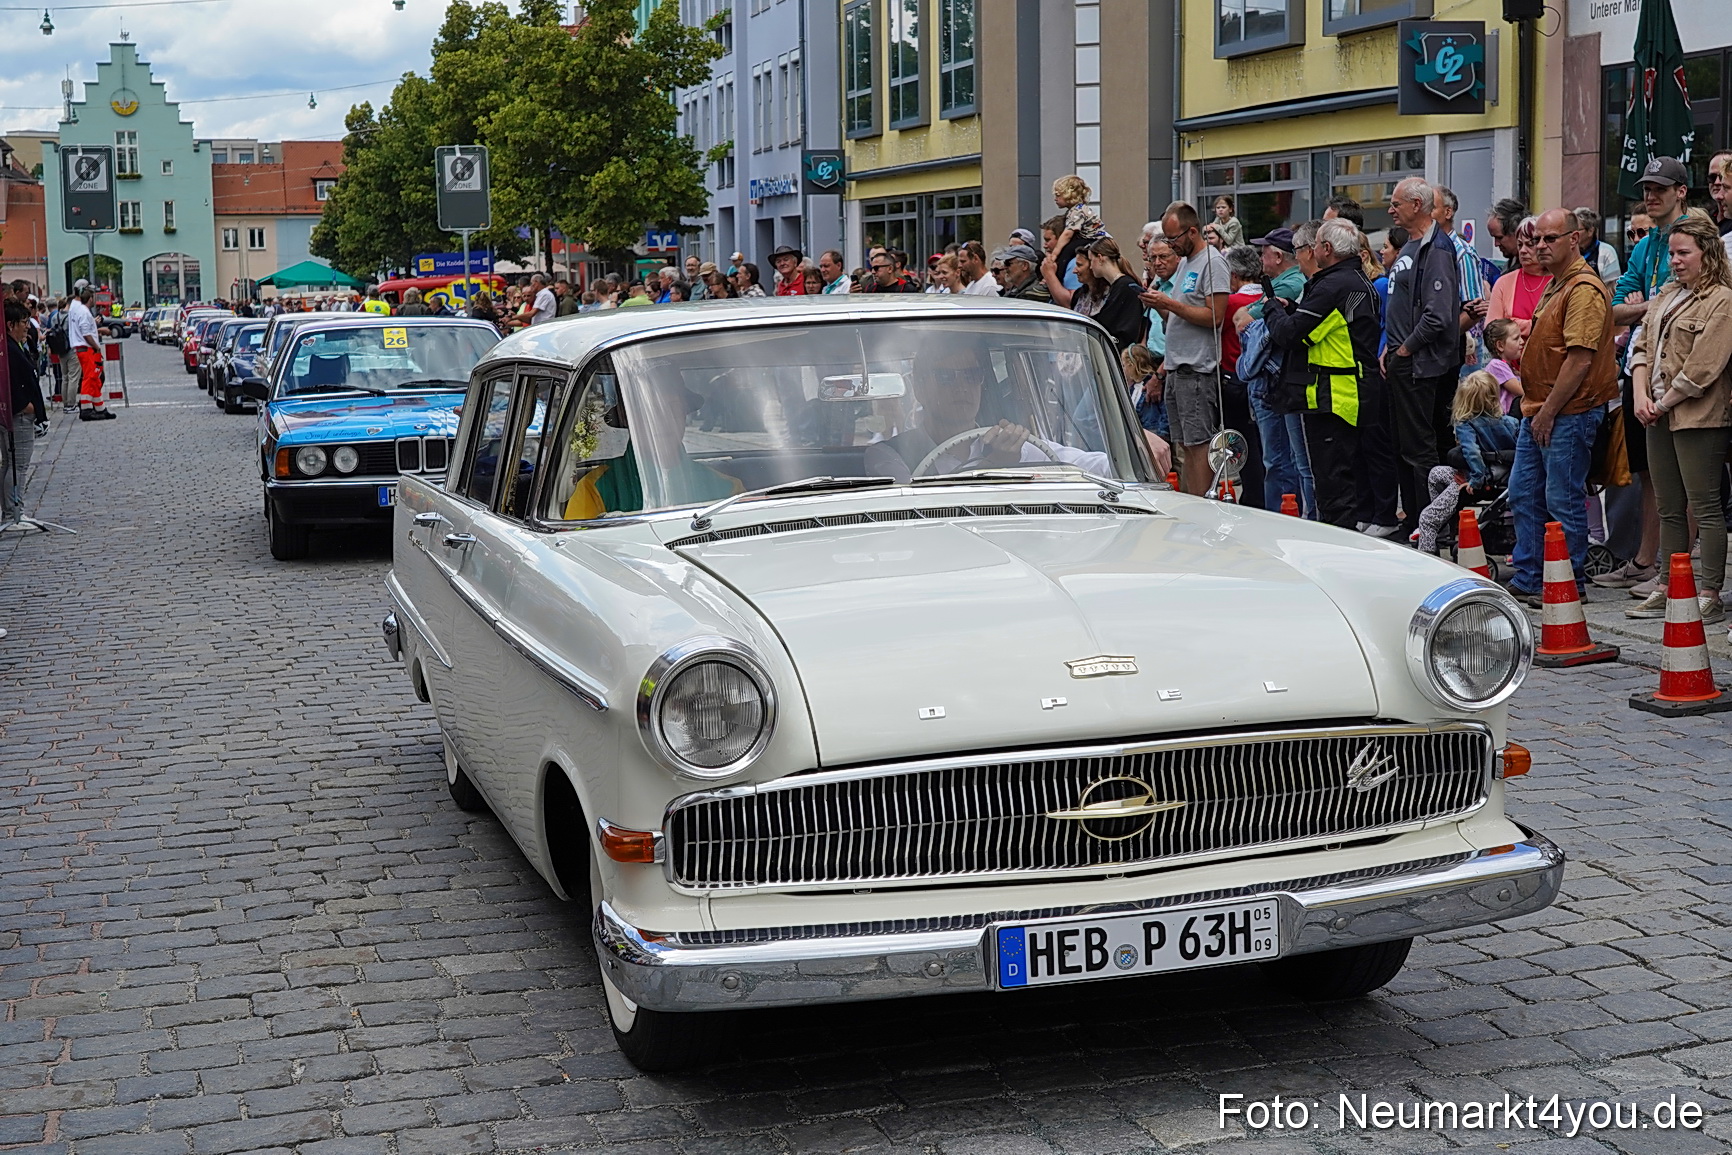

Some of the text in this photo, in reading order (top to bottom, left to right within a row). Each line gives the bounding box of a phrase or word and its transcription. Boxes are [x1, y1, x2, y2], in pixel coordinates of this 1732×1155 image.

[1590, 0, 1640, 20] Unterer Mar
[1435, 46, 1464, 84] G2
[817, 161, 833, 180] G2
[79, 182, 98, 190] ZONE
[446, 259, 481, 267] Knödeletter
[386, 336, 407, 346] 26
[1253, 906, 1272, 921] 05
[1028, 926, 1110, 978] HEB
[1142, 920, 1167, 966] P
[1178, 909, 1252, 961] 63H
[1253, 937, 1273, 952] 09
[1007, 963, 1019, 977] D
